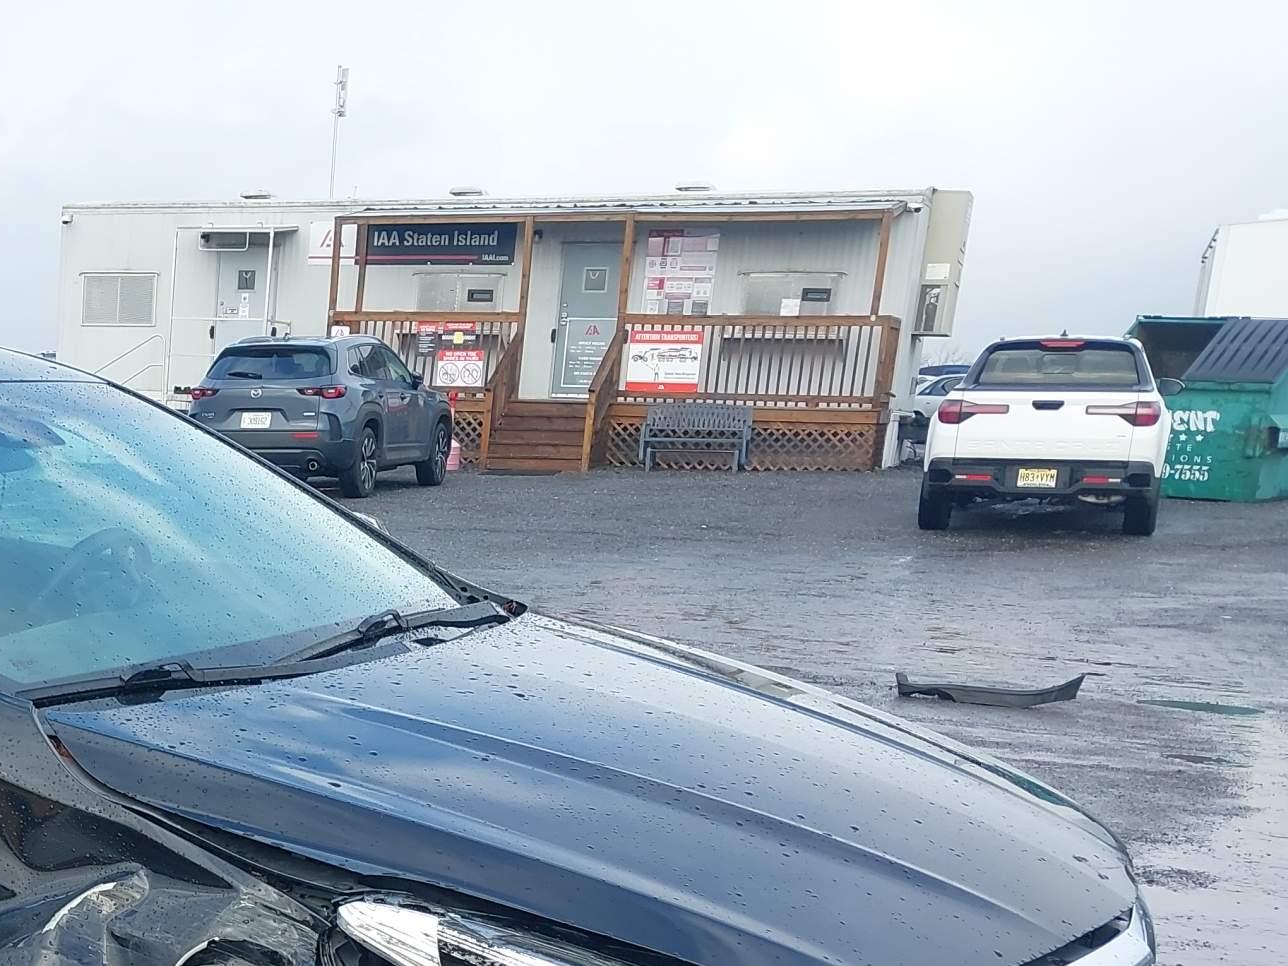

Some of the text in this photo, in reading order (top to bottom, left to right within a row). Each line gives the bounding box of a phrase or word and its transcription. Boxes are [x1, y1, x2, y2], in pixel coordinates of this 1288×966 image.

[373, 230, 498, 247] IAA Staten Island
